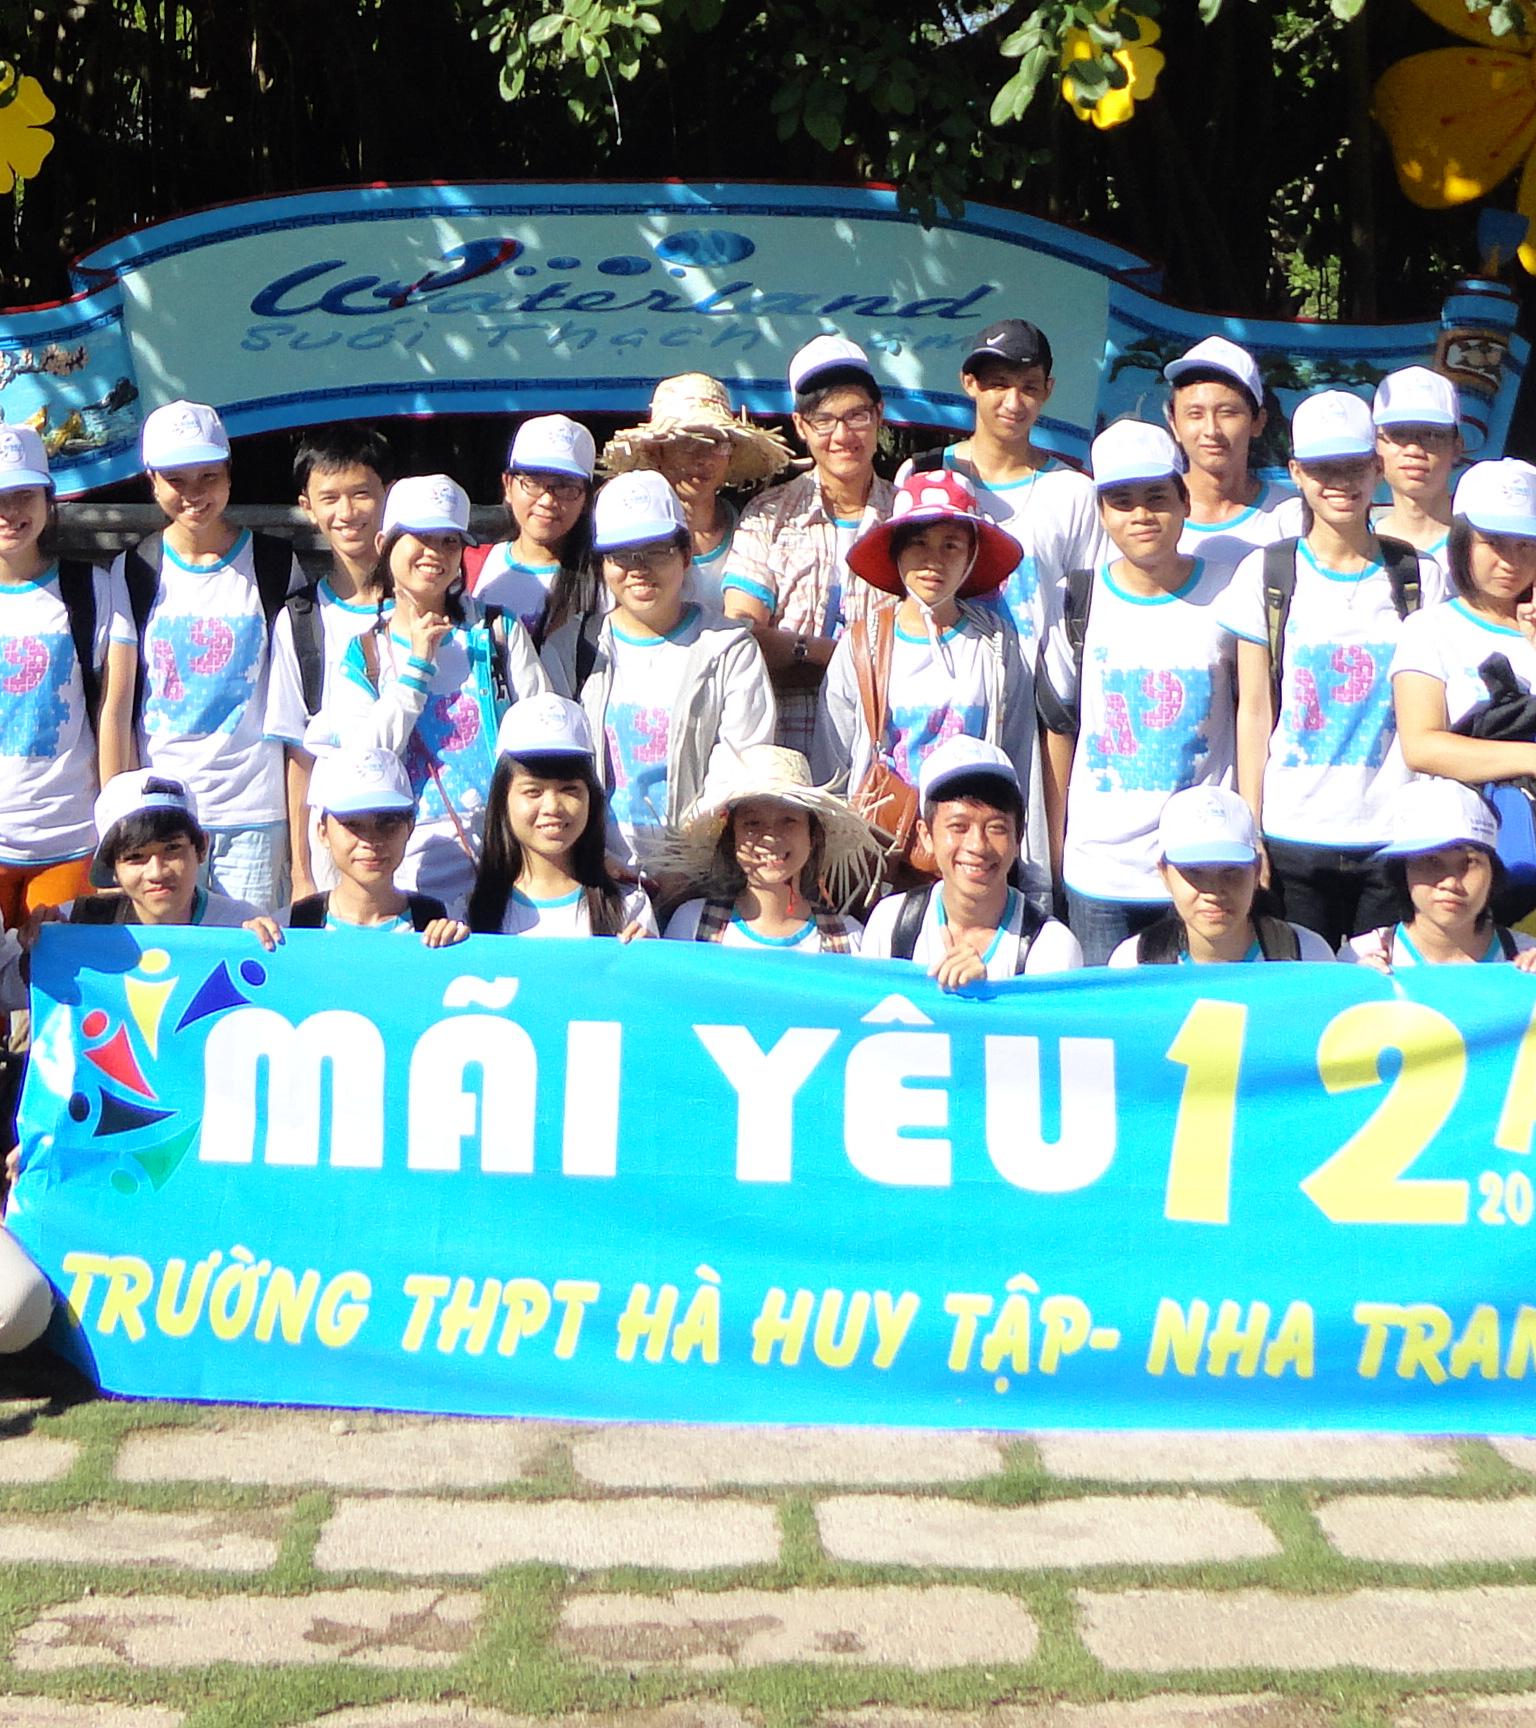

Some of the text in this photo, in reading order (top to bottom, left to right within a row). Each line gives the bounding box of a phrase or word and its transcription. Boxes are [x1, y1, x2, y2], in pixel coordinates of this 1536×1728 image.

[250, 238, 997, 320] Waterland
[1098, 669, 1184, 755] A9
[1292, 644, 1376, 731] A9
[200, 975, 622, 1178] MÃI
[693, 993, 1118, 1194] YÊU
[62, 1243, 372, 1348] TRƯỜNG
[401, 1274, 600, 1359] THPT
[616, 1264, 723, 1366] HÀ
[752, 1286, 920, 1371] HUY
[1145, 1298, 1317, 1381] NHA
